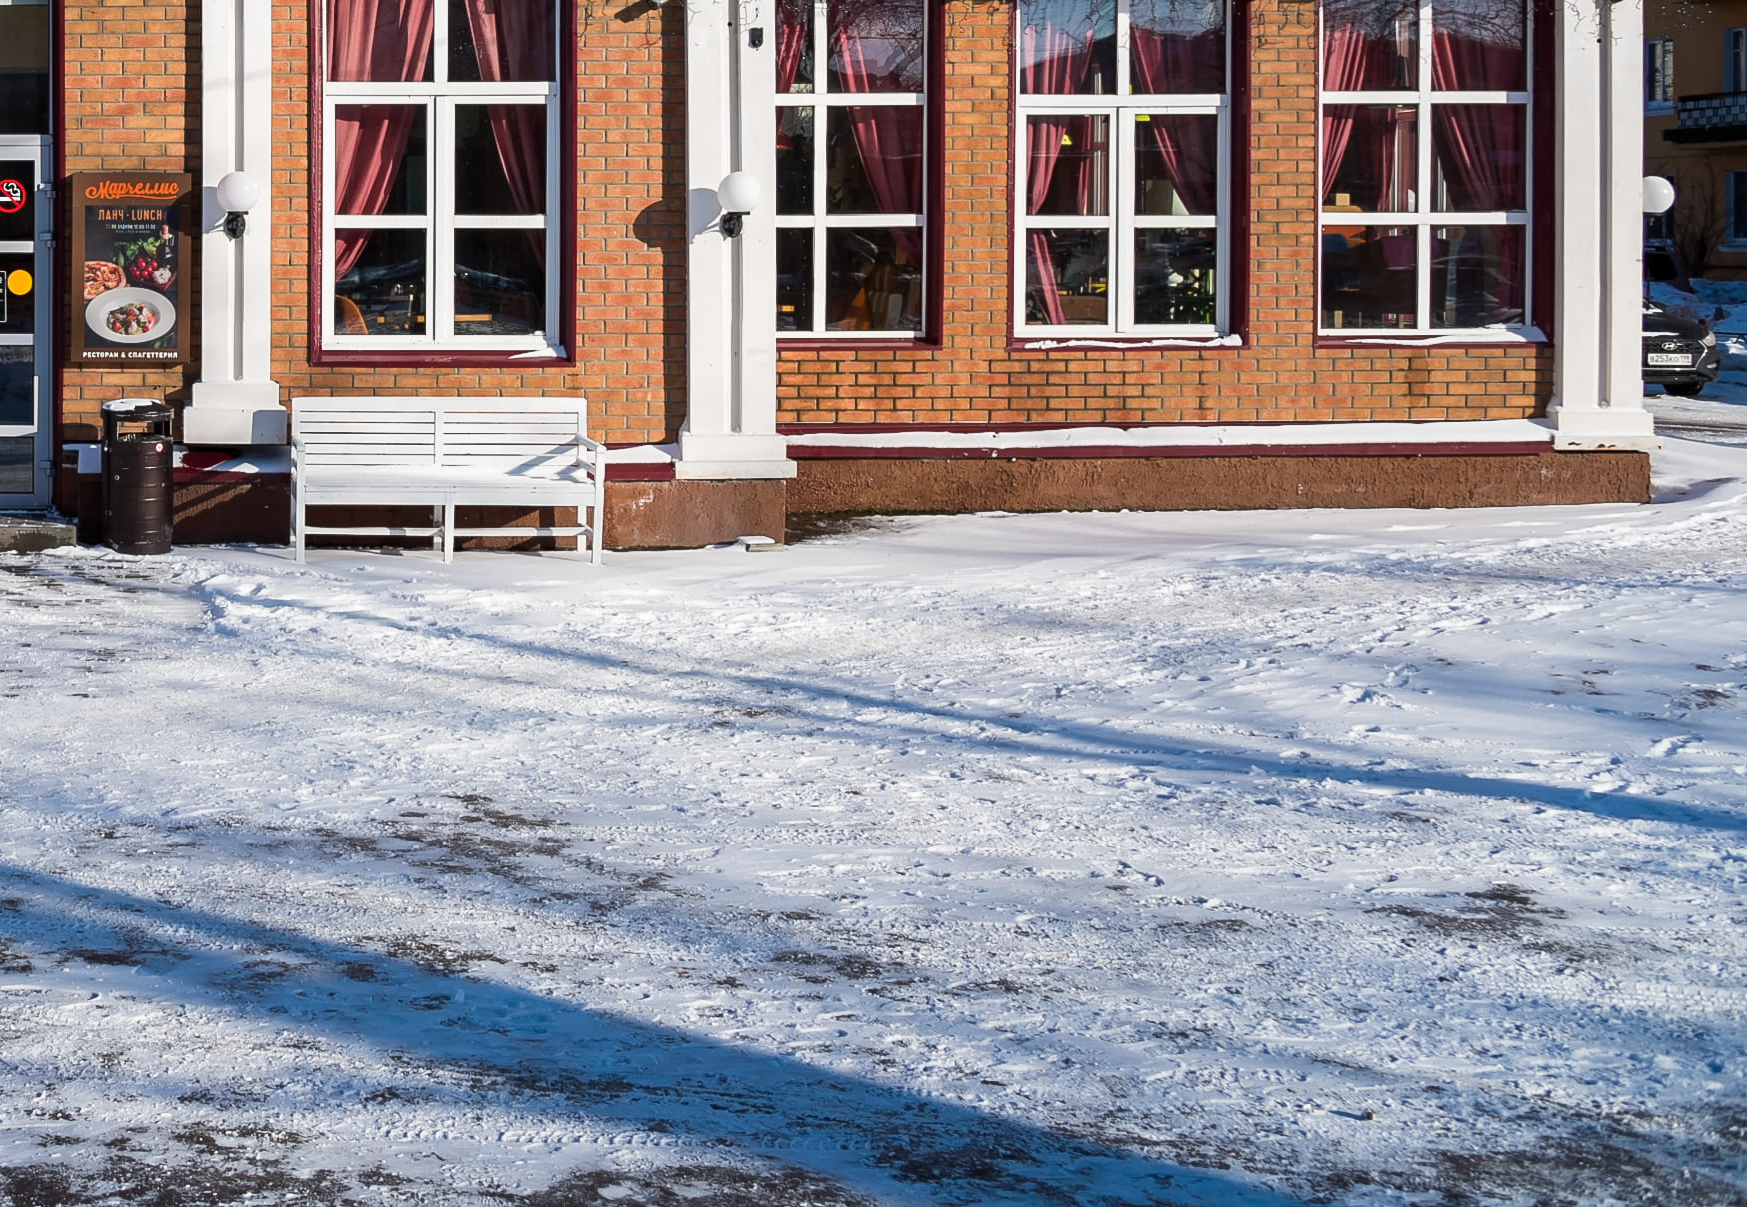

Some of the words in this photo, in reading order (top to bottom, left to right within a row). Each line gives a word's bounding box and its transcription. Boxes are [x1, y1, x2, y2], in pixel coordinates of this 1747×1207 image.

[85, 180, 179, 200] Марчеллис
[97, 209, 124, 221] ЛАНЧ
[131, 209, 163, 221] LUNCH
